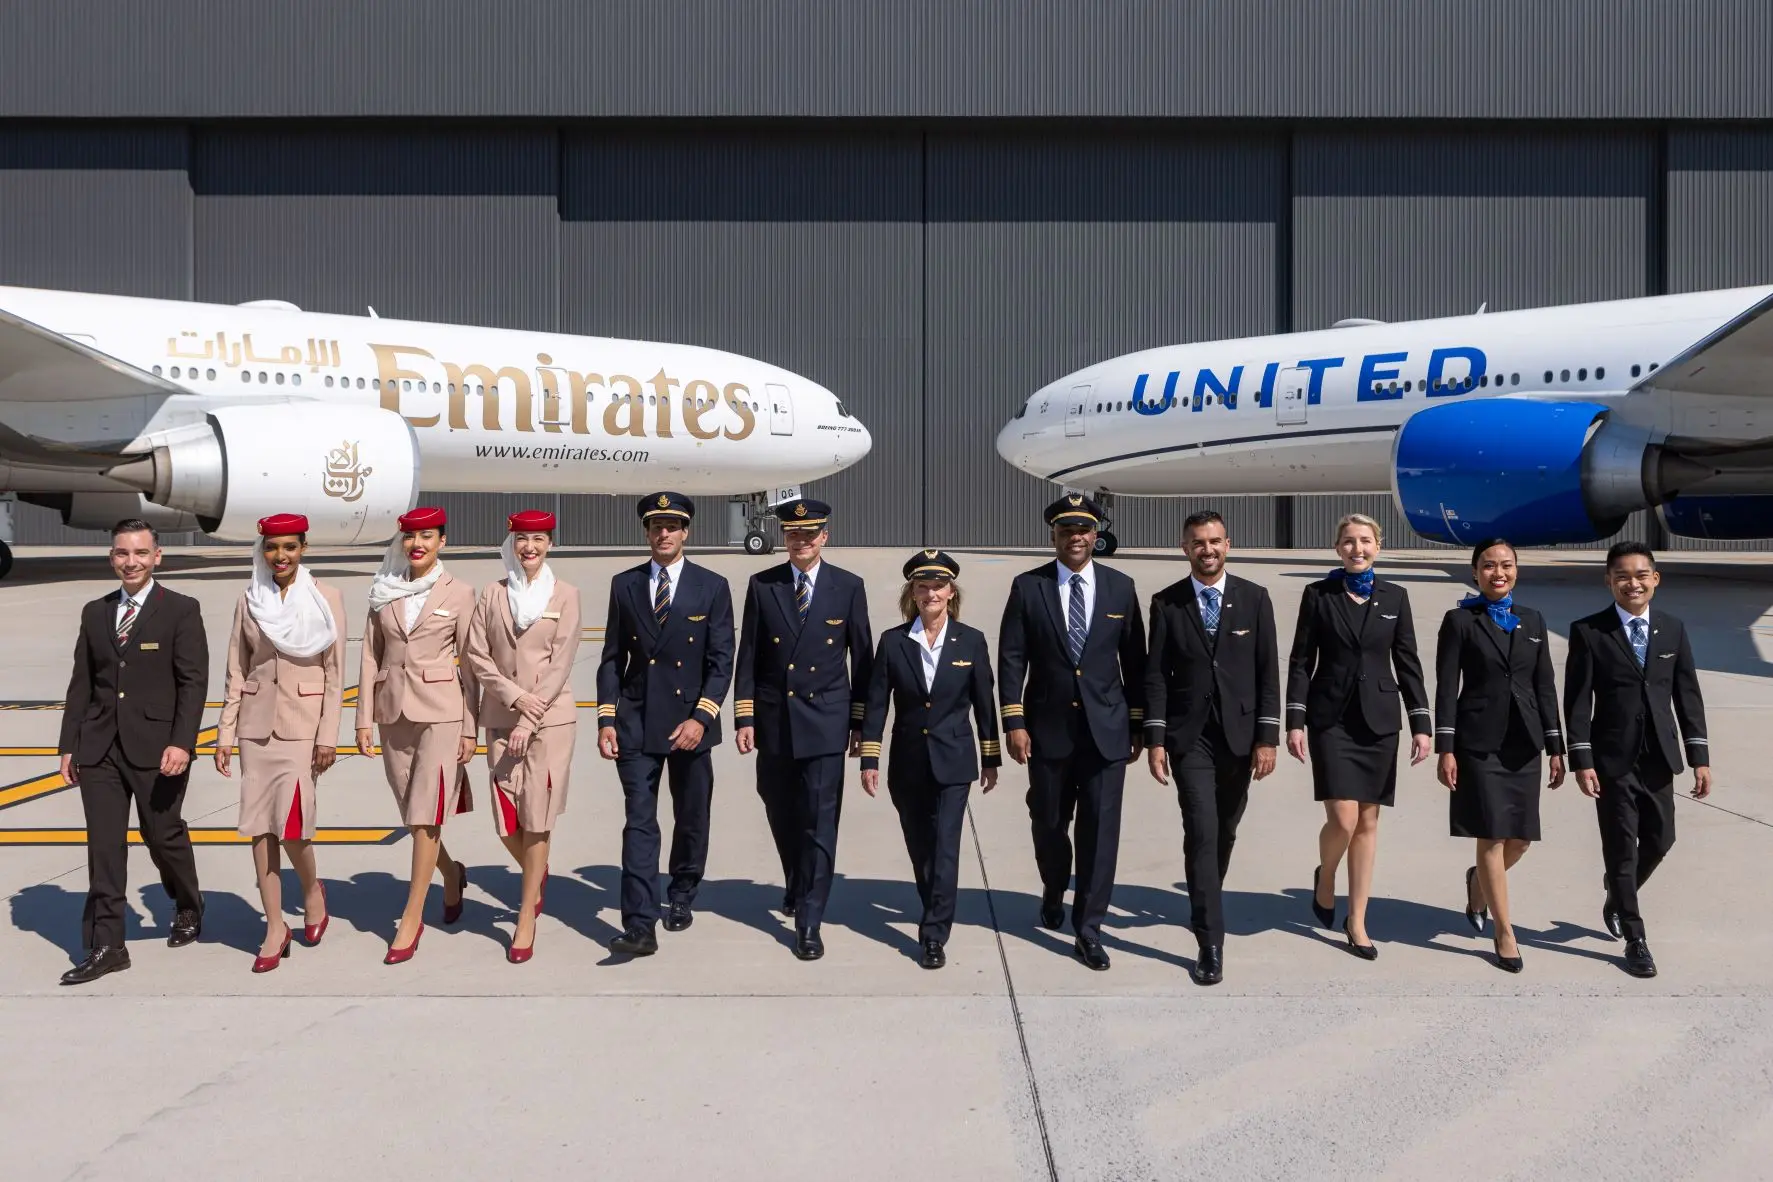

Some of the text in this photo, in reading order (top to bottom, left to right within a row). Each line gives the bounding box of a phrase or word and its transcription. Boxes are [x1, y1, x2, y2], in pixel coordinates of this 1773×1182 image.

[366, 342, 756, 441] Emirates
[1131, 346, 1487, 416] UNITED
[475, 443, 650, 463] www.emirates.com
[781, 488, 794, 499] QG
